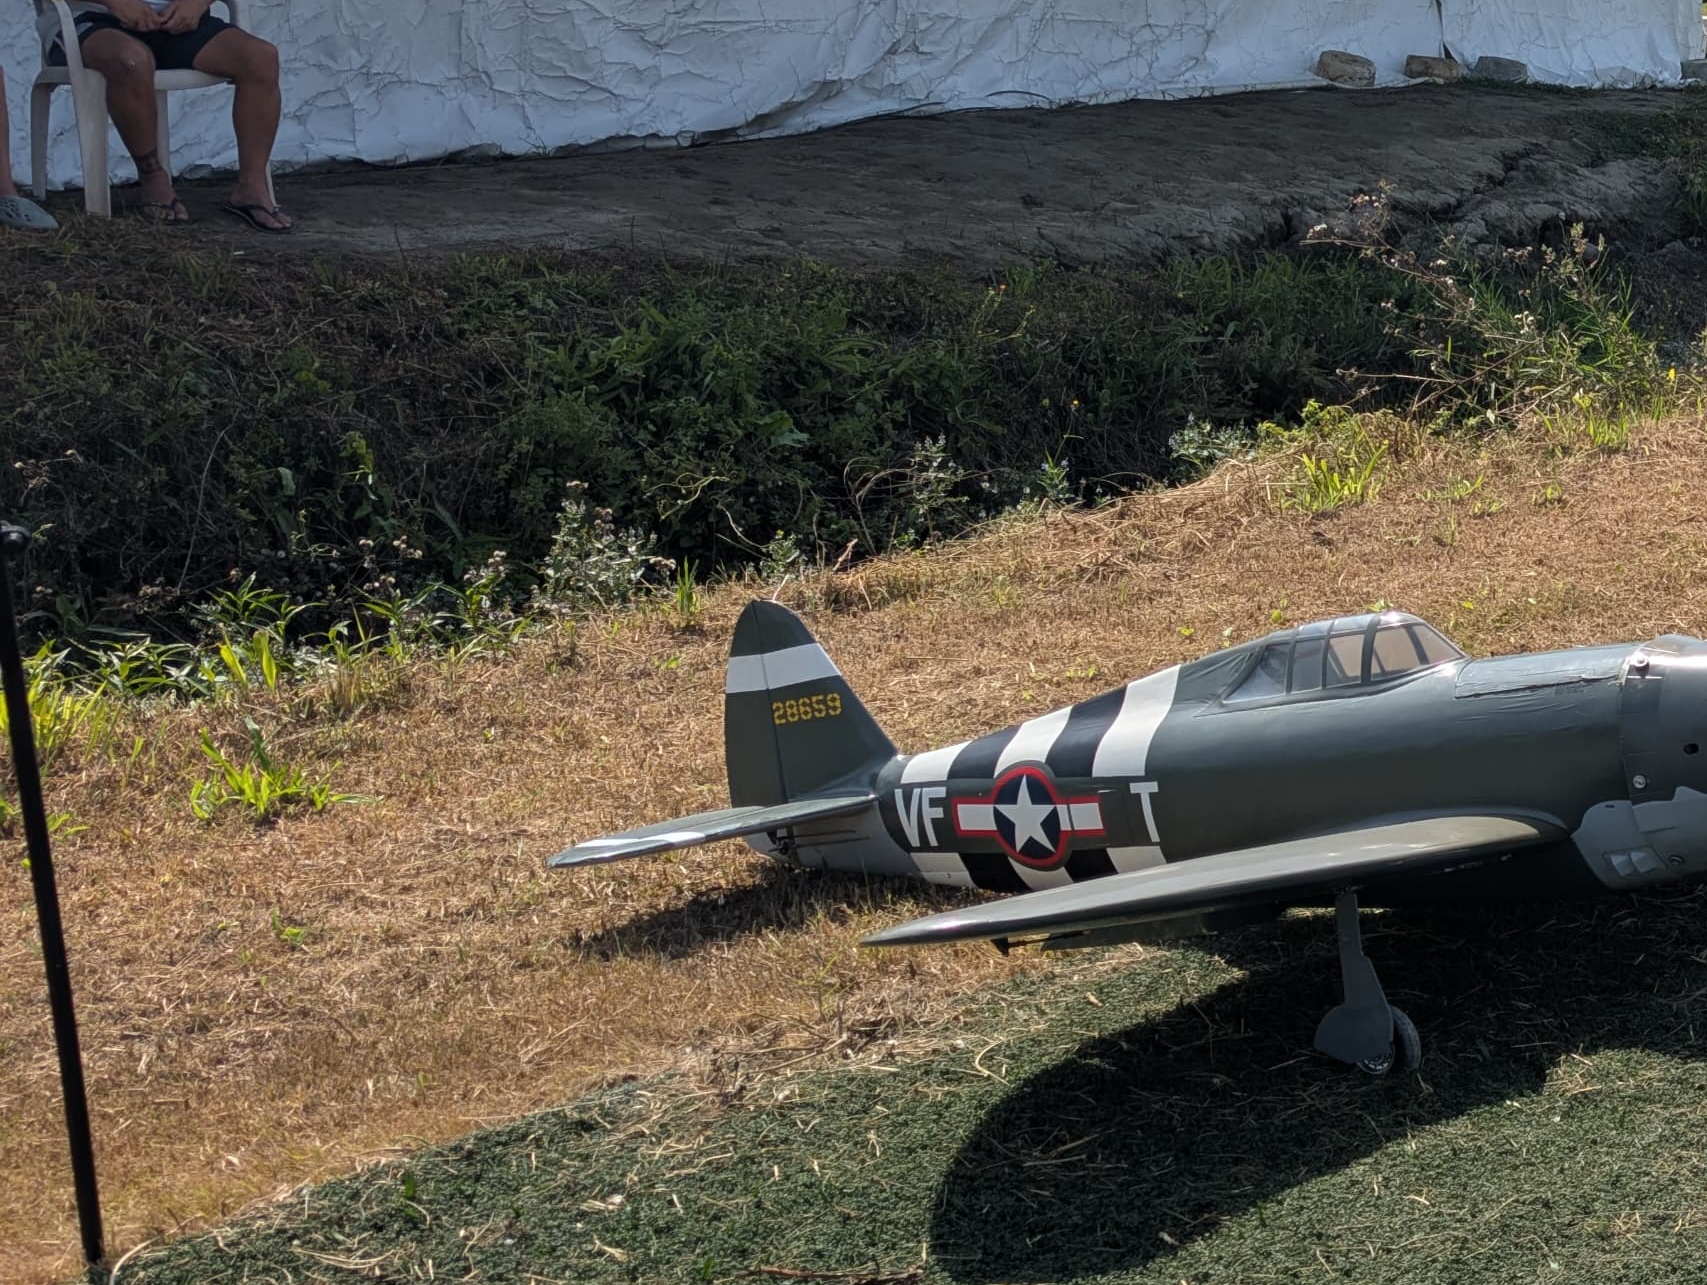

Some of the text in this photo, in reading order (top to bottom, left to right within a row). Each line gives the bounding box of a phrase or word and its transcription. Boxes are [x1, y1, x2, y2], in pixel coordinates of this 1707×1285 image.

[772, 693, 842, 724] 28659
[894, 781, 1161, 847] VF T
